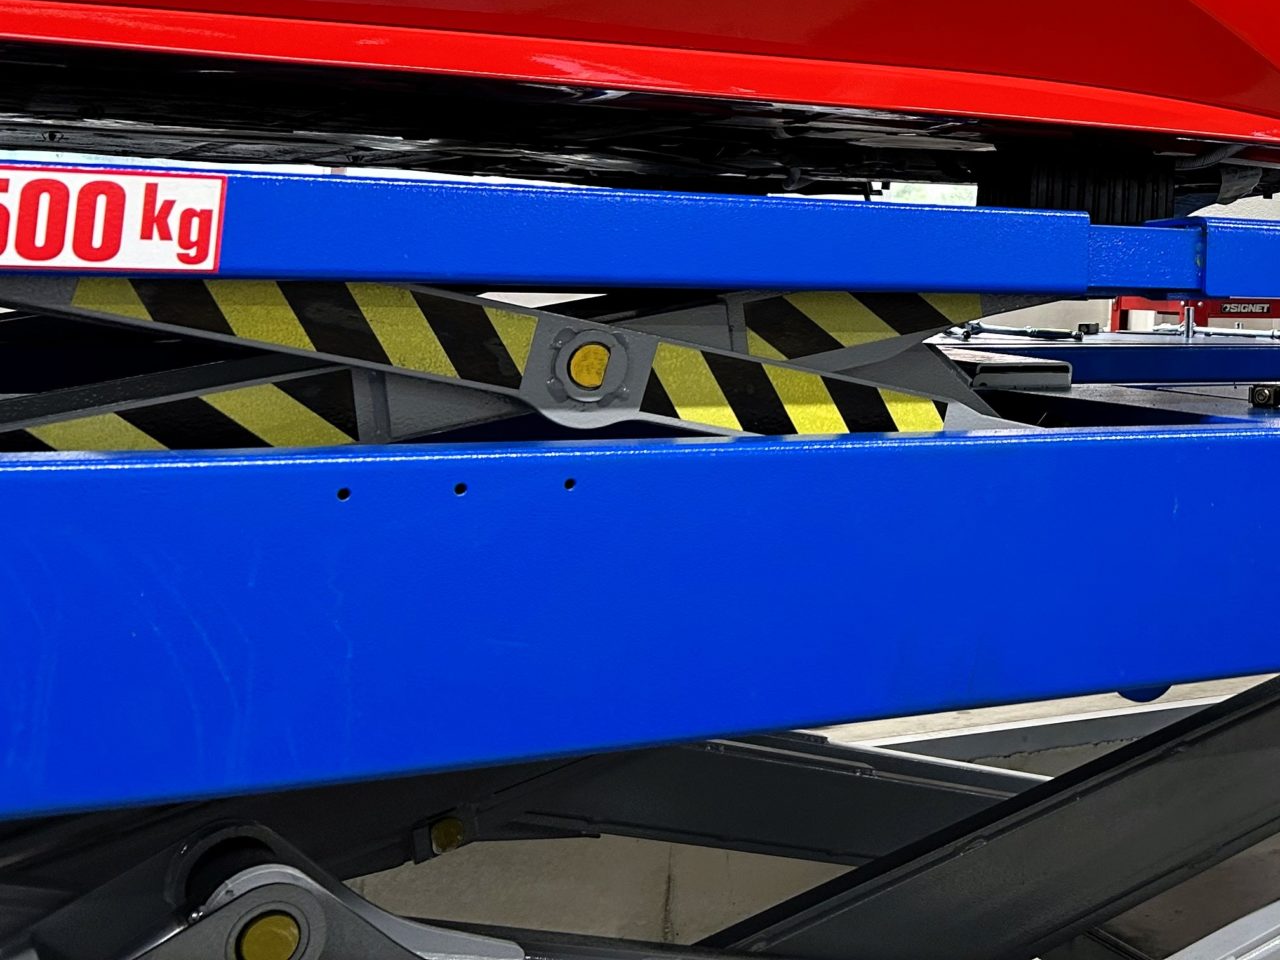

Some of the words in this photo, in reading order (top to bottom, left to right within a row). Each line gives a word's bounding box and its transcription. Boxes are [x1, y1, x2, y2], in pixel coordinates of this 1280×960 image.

[0, 178, 127, 262] 00
[140, 182, 214, 265] kg
[1229, 303, 1270, 313] SIGNET
